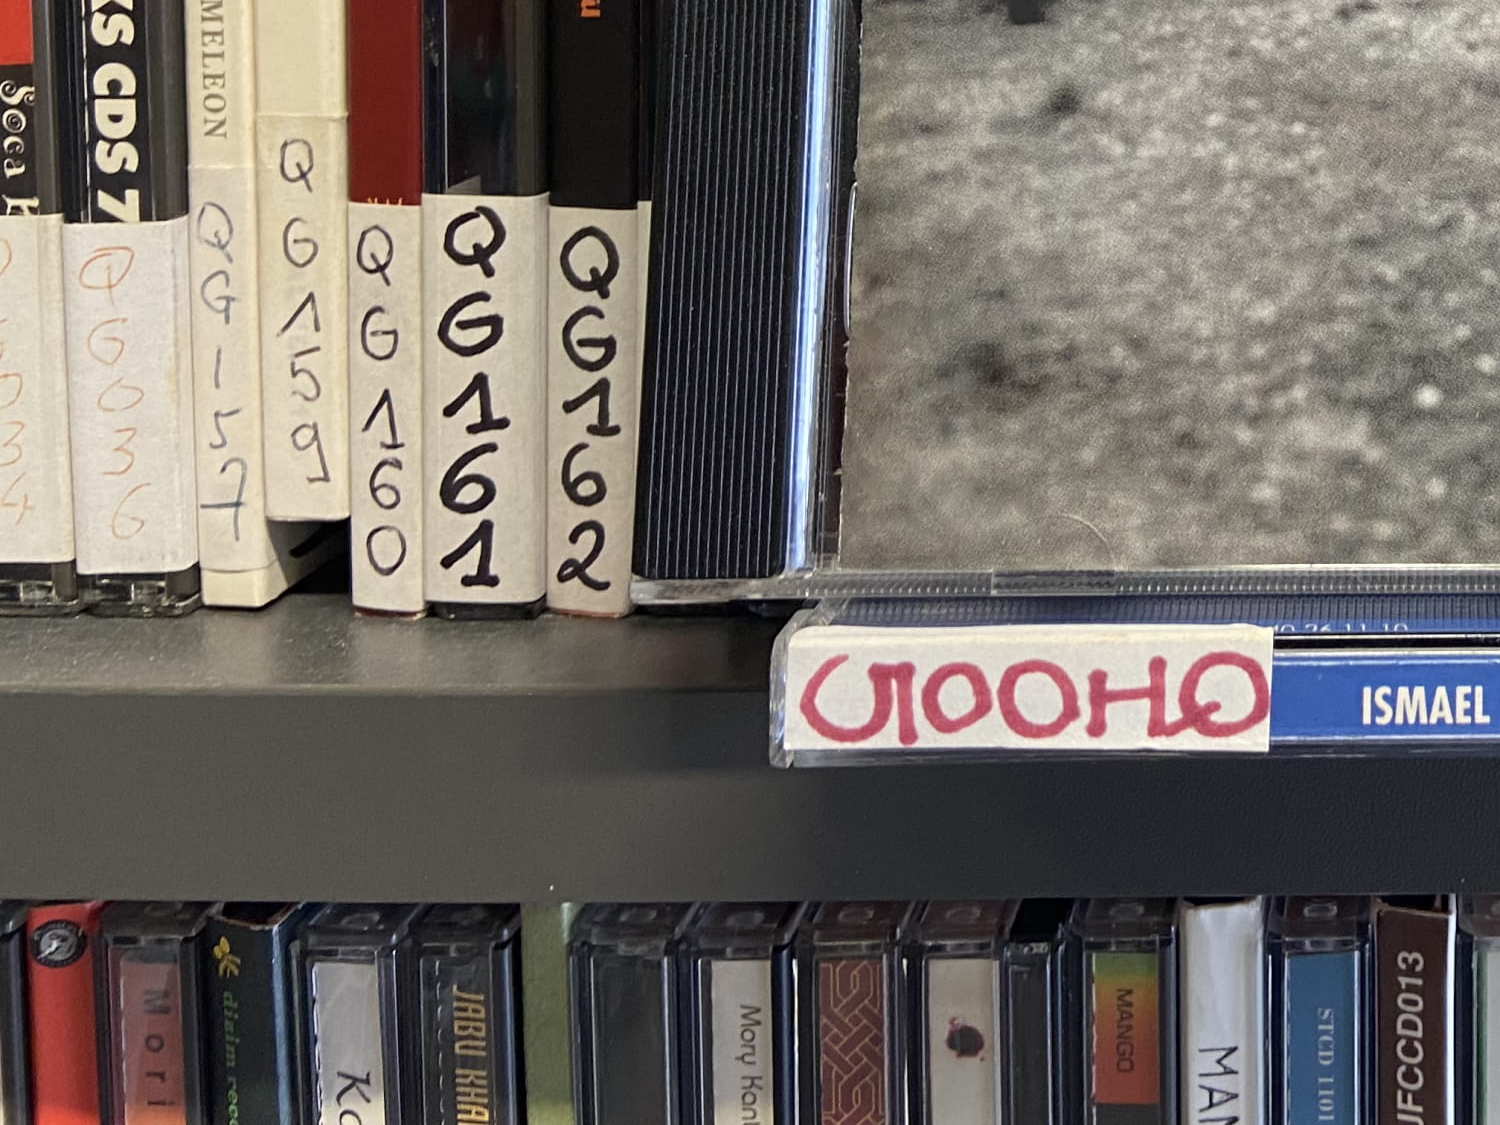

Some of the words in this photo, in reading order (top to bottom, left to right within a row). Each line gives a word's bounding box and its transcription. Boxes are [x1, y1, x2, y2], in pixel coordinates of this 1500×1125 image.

[92, 62, 140, 177] CDS
[1361, 685, 1492, 726] ISMAEL
[452, 985, 487, 1057] JABU
[734, 1004, 762, 1066] Mory
[1116, 987, 1135, 1073] MANGO
[1317, 1007, 1335, 1066] STCD
[454, 1067, 490, 1125] KHA
[741, 1075, 764, 1125] Kan
